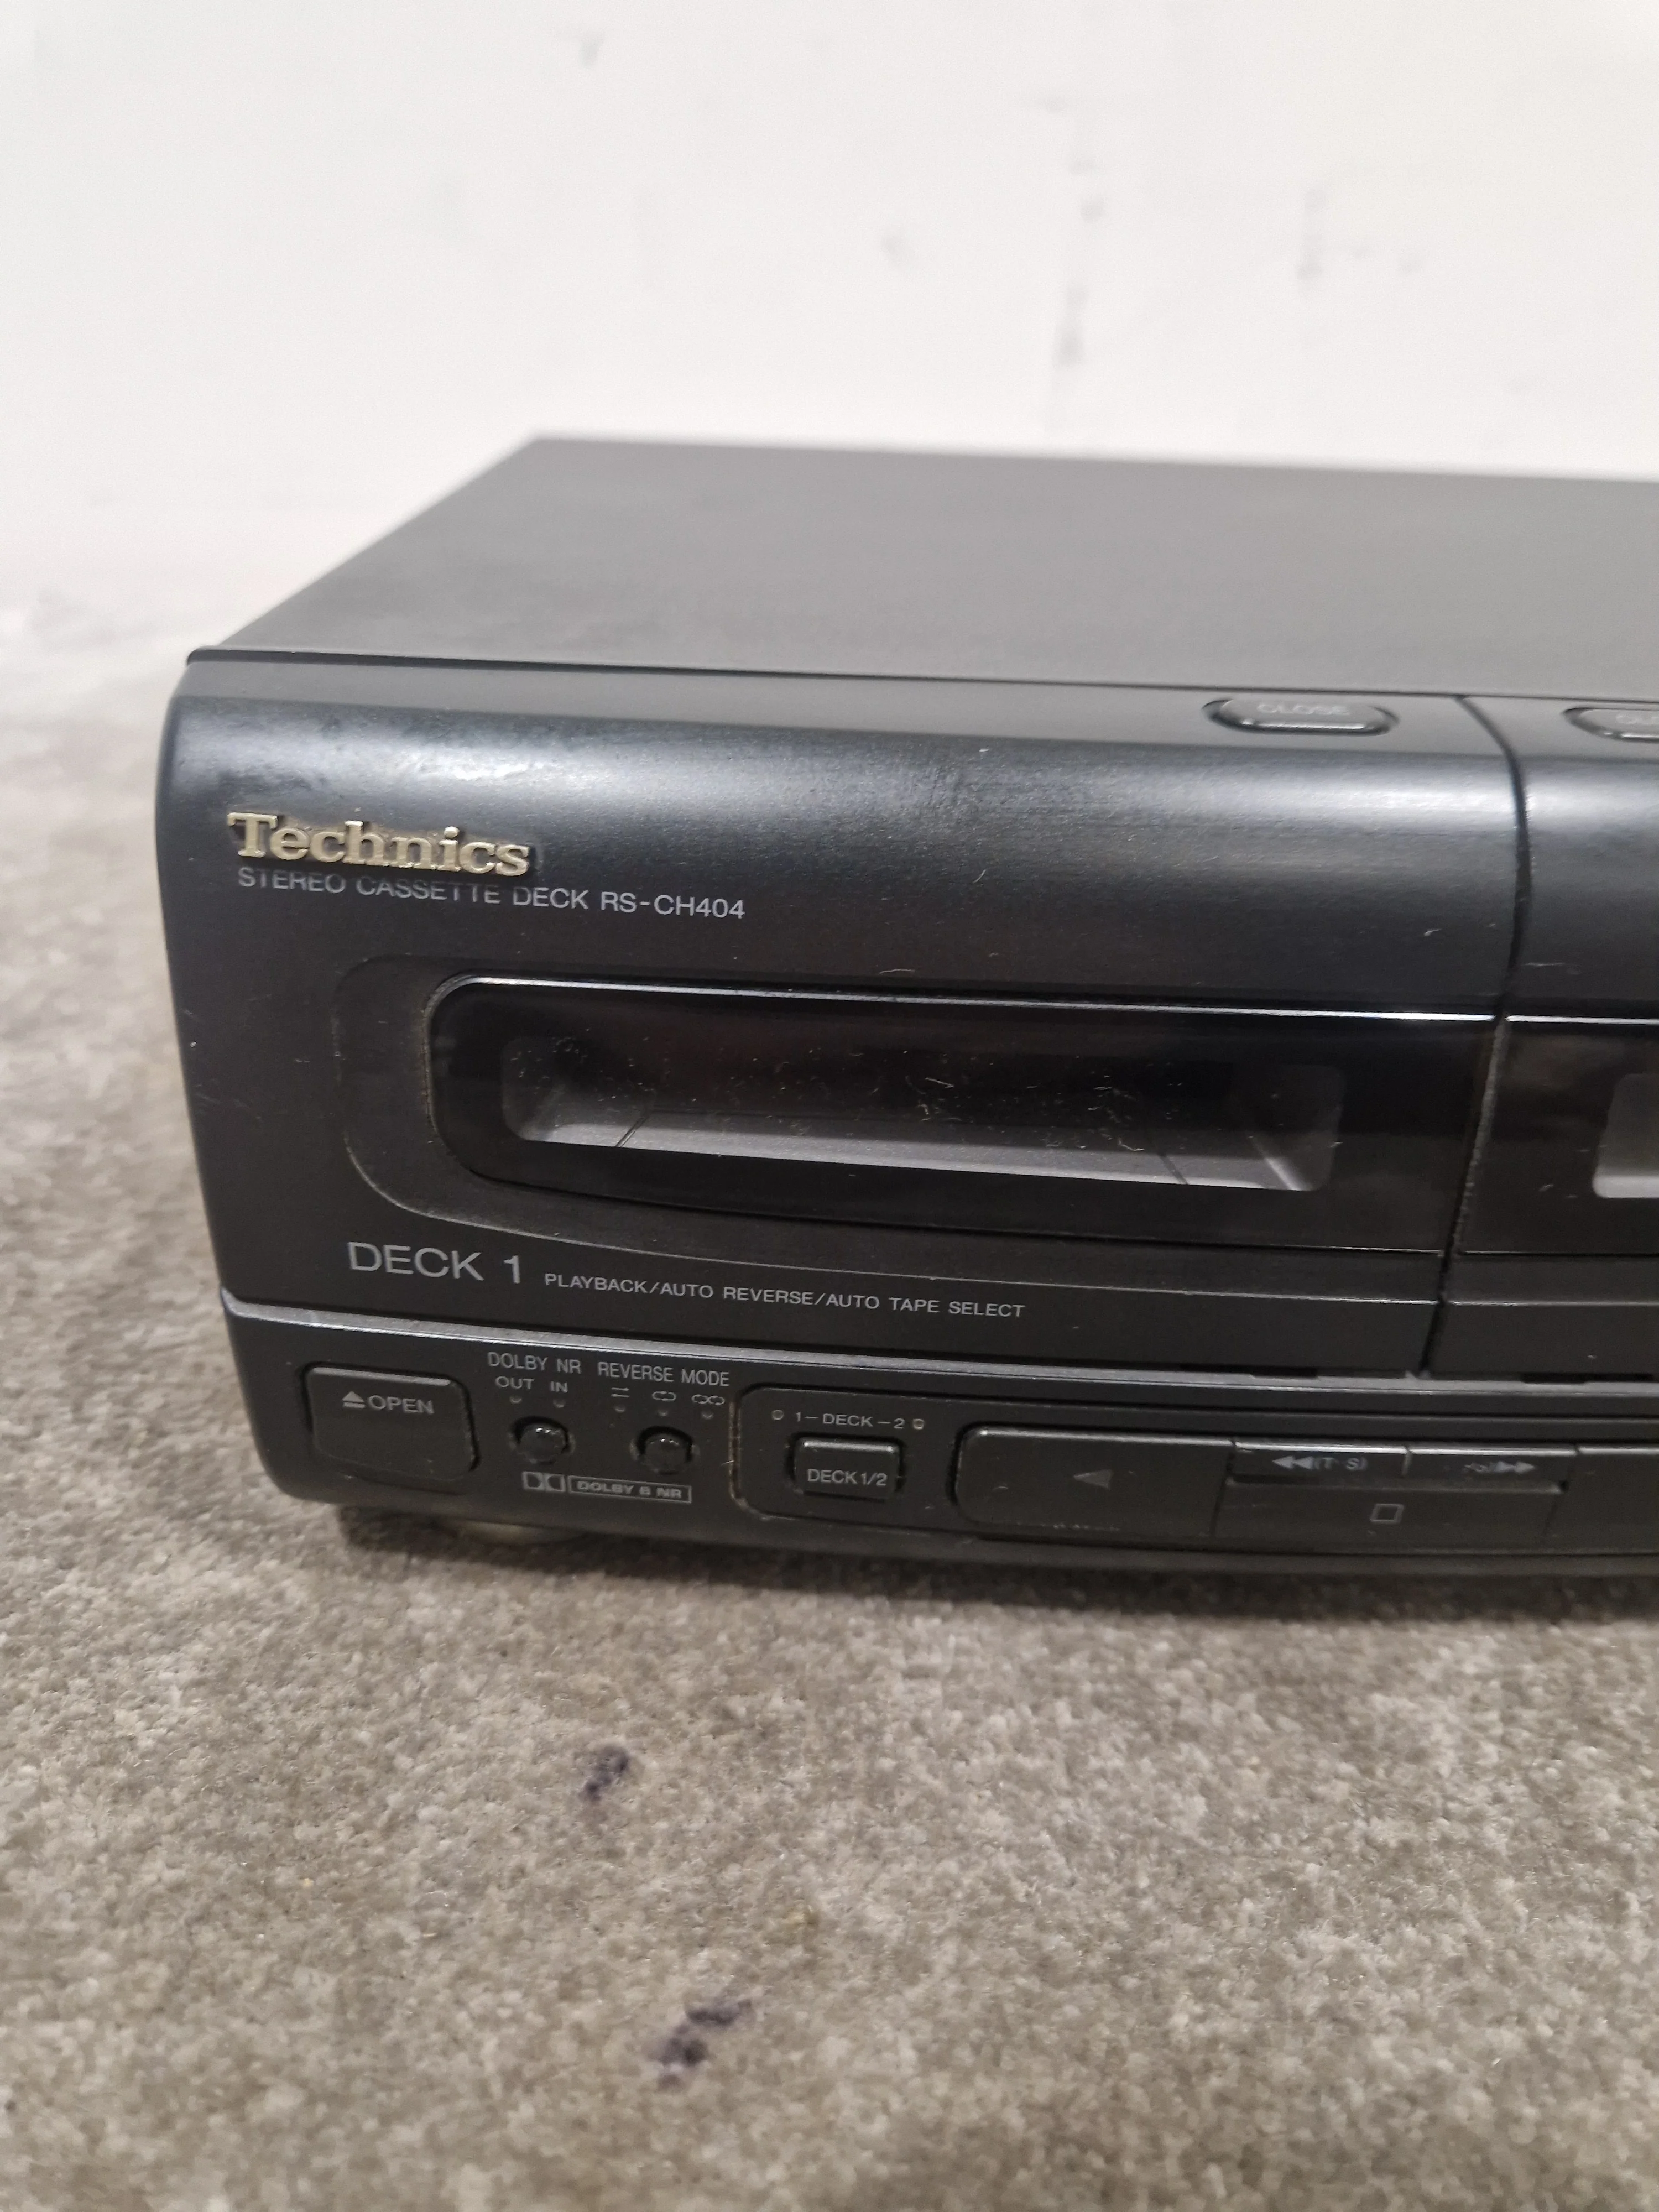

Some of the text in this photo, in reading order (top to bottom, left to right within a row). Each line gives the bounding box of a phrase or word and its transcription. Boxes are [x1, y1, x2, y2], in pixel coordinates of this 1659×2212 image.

[227, 811, 530, 877] Technics
[237, 867, 746, 920] STEREO CASSETTE DECK RS-CH404
[348, 1241, 523, 1284] DECK 1
[544, 1273, 1026, 1318] PLAYBACK/AUTO REVERSE/AUTO TAPE SELECT
[487, 1352, 582, 1374] DOLBY NR
[597, 1361, 730, 1387] REVERSE MODE
[494, 1376, 535, 1390] OUT
[549, 1381, 569, 1394] IN
[367, 1394, 435, 1415] OPEN
[577, 1480, 634, 1494] DOLBY
[656, 1488, 682, 1498] NR
